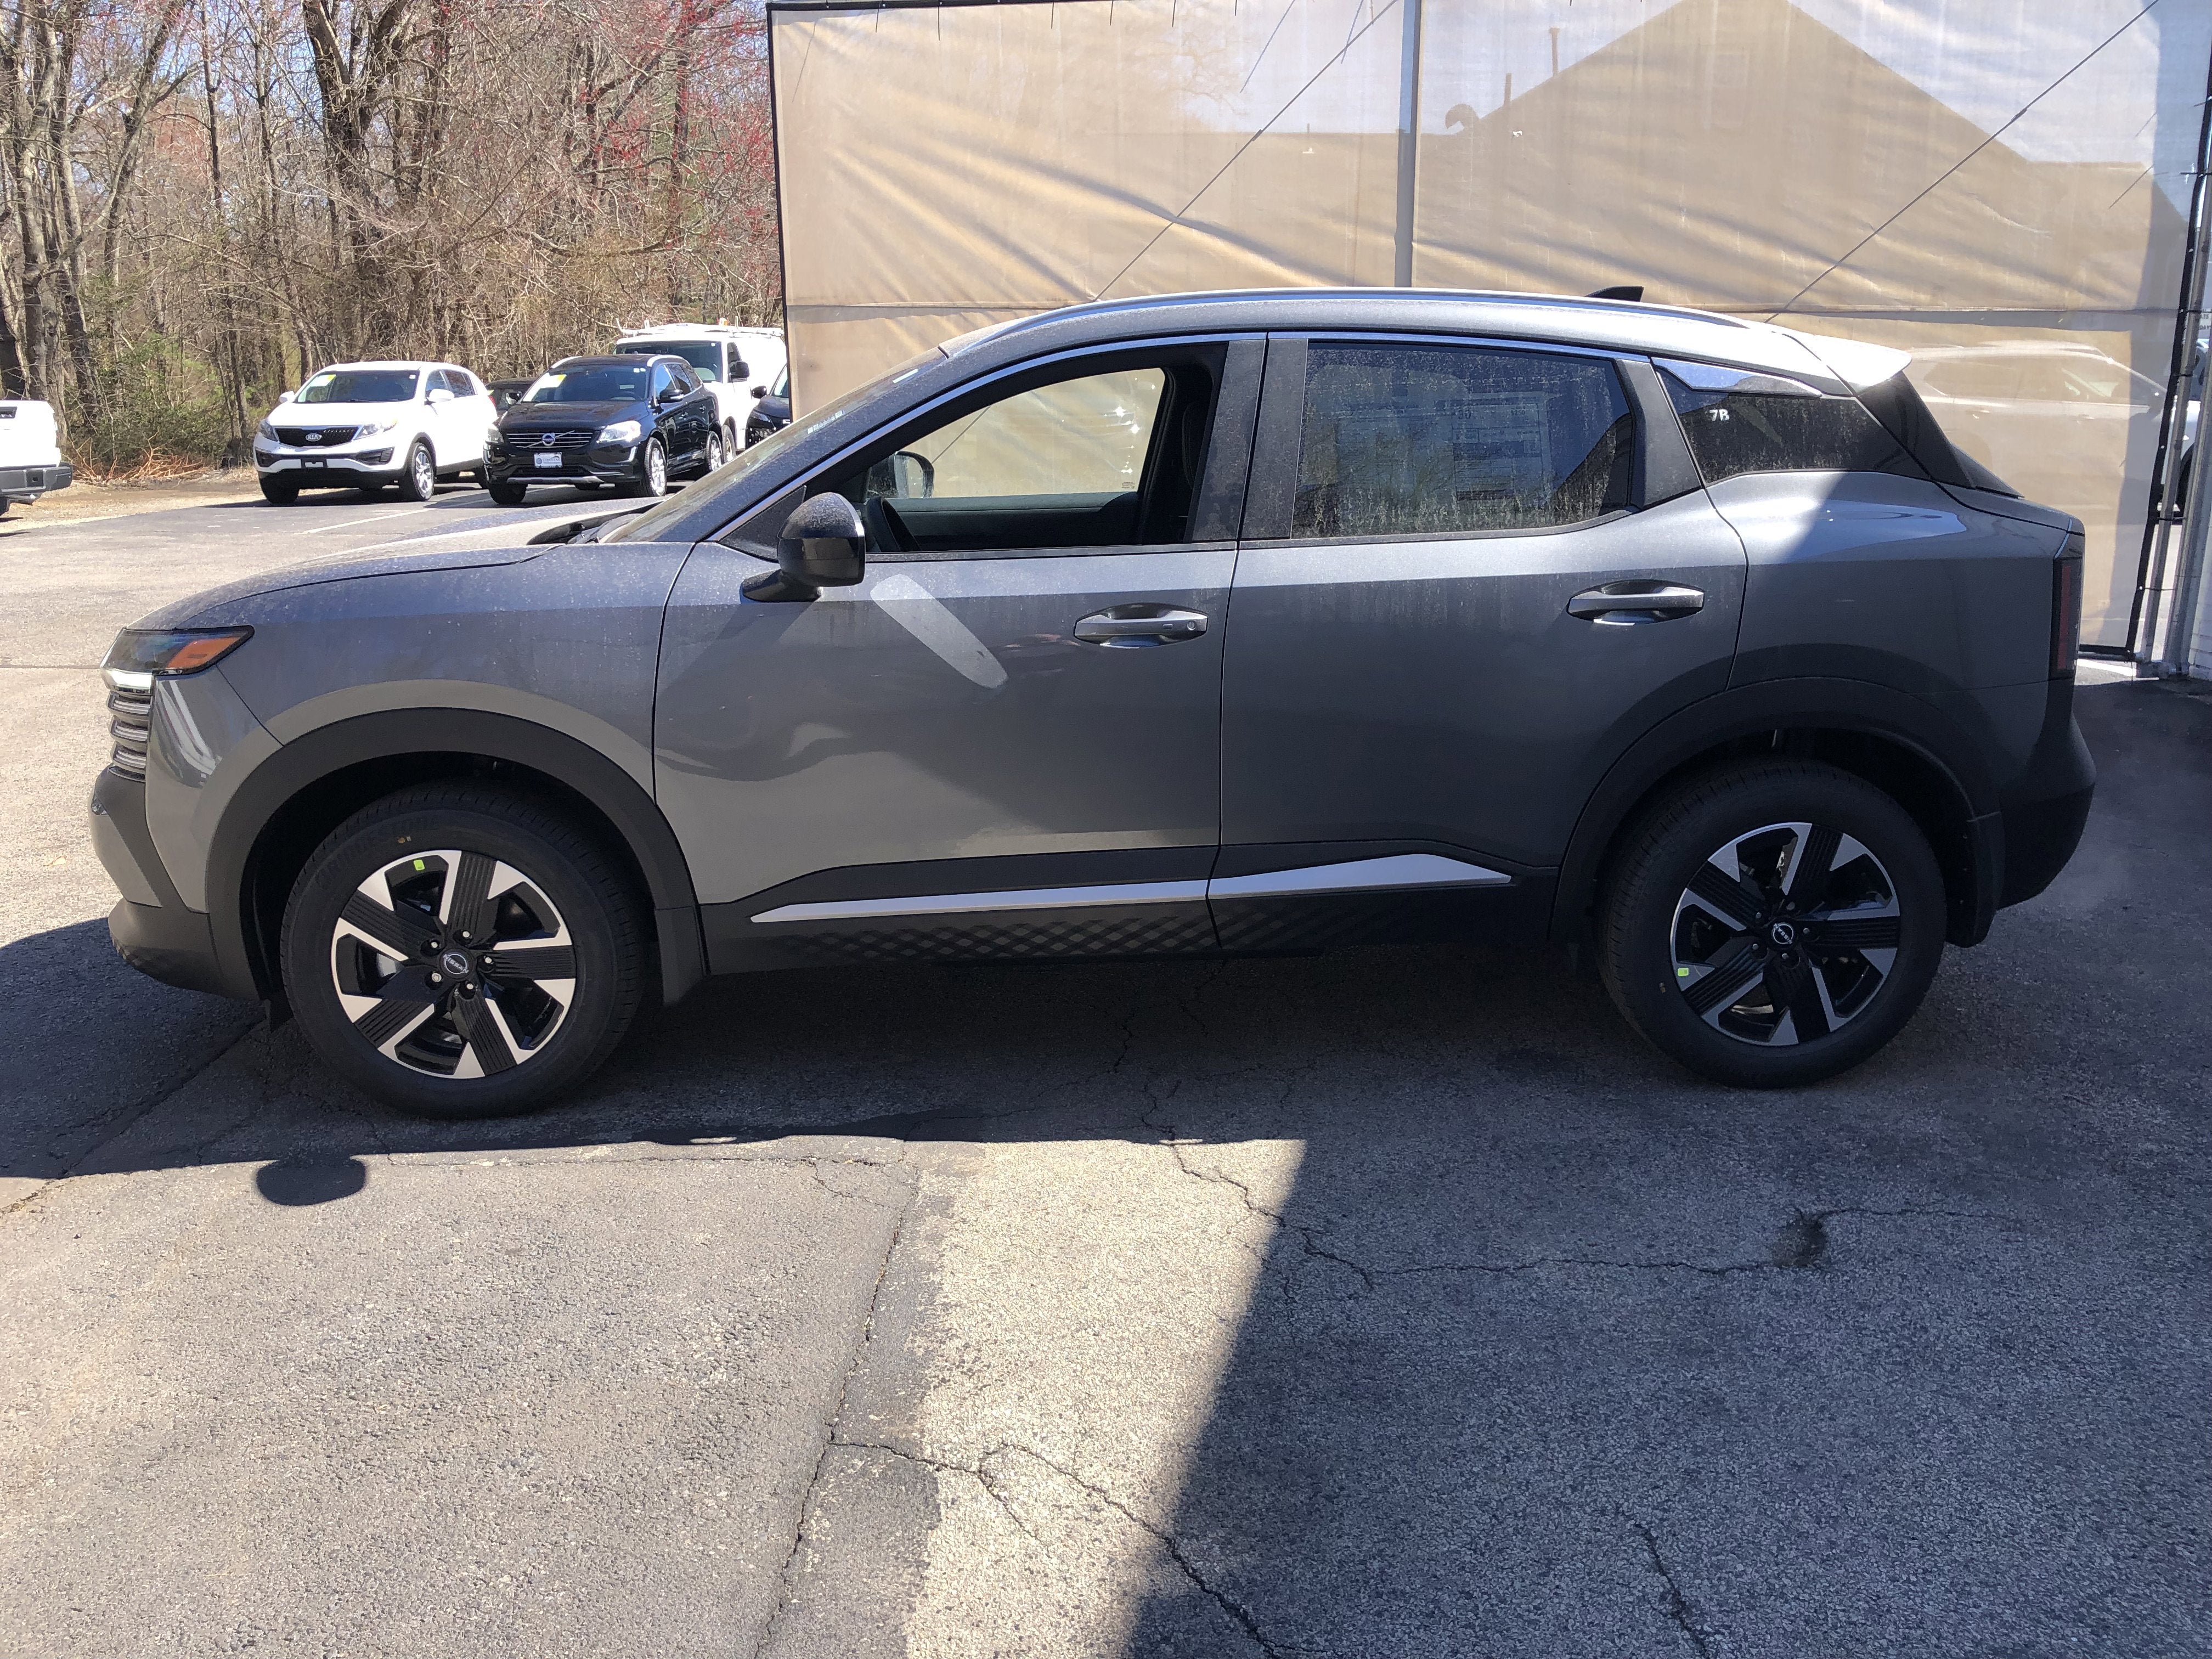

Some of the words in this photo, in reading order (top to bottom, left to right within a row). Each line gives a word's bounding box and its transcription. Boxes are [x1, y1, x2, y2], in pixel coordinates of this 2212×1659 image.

[1709, 409, 1730, 421] 7B
[1774, 923, 1792, 944] NISSAN
[443, 954, 469, 973] NISSAN
